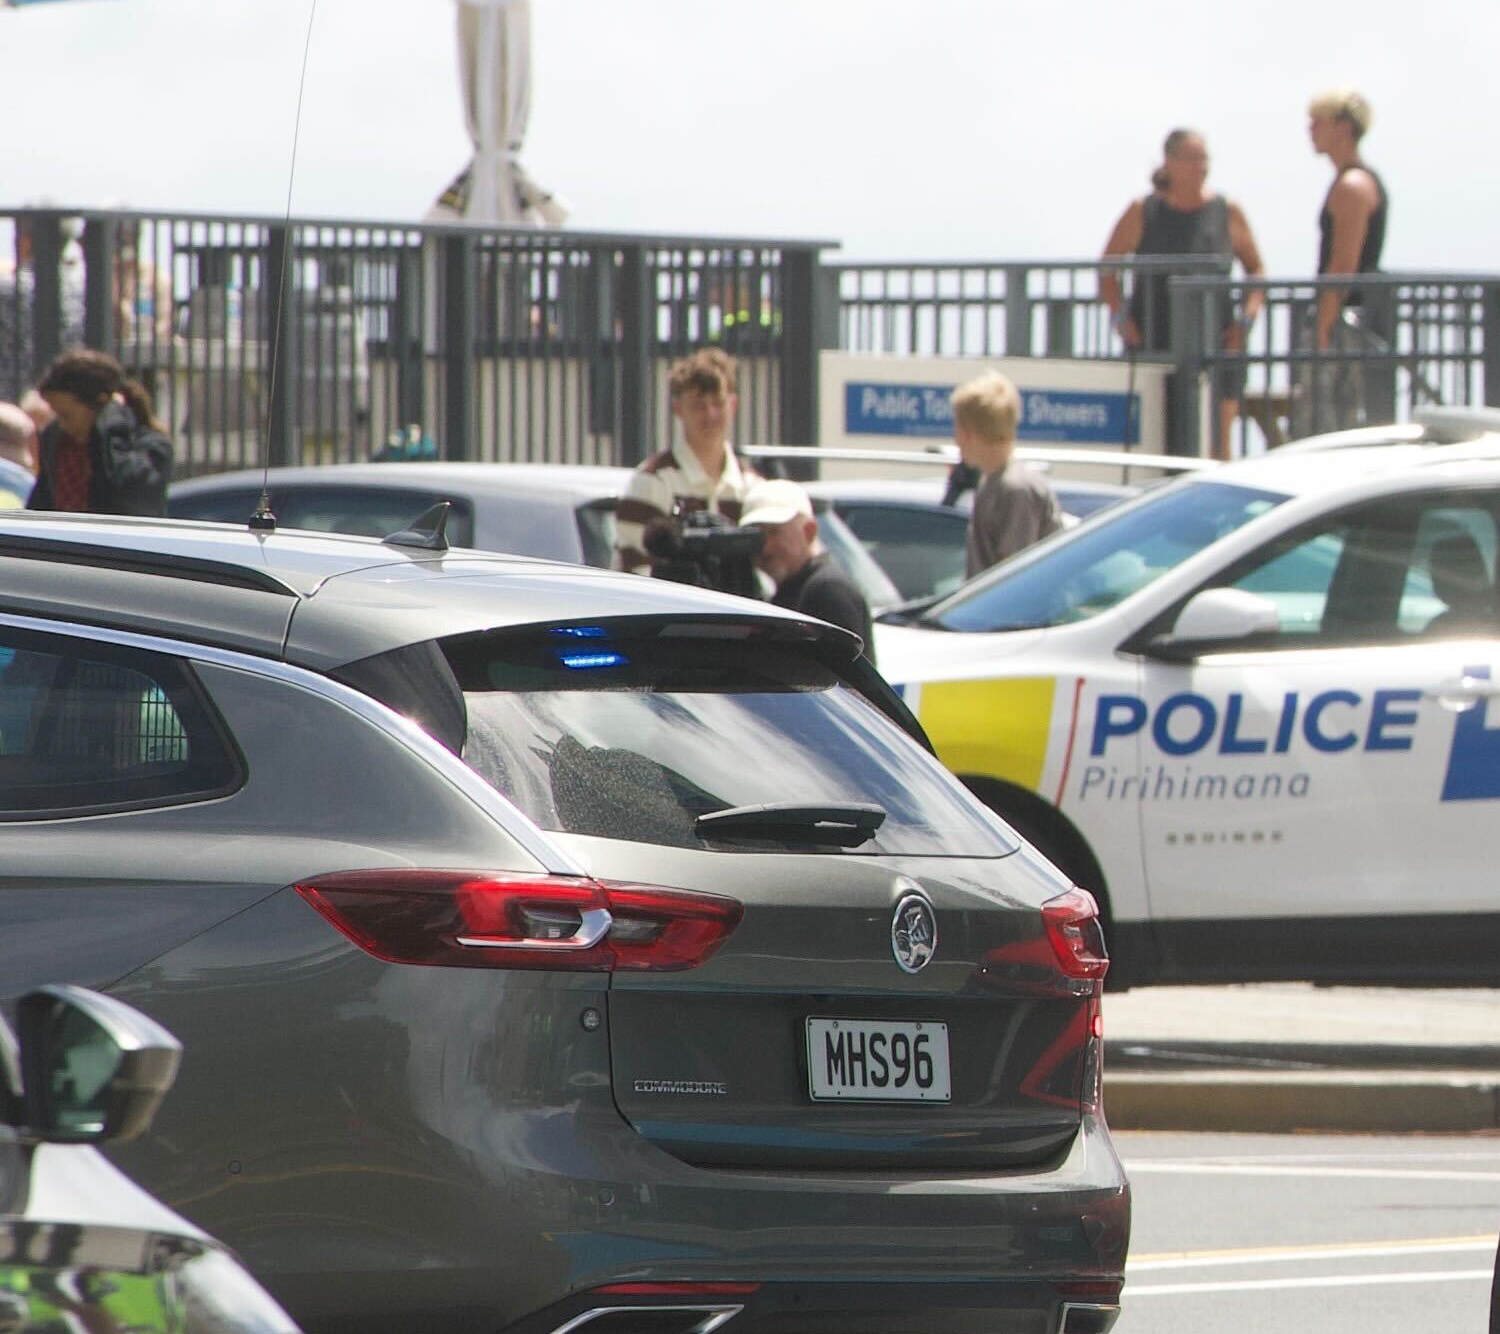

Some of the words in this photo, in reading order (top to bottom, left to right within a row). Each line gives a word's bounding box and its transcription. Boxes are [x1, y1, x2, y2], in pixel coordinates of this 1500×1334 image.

[862, 387, 919, 419] Public
[1027, 394, 1108, 427] Showers
[1090, 689, 1423, 757] POLICE
[1079, 765, 1312, 801] Pirihimana
[825, 1031, 933, 1089] MHS96
